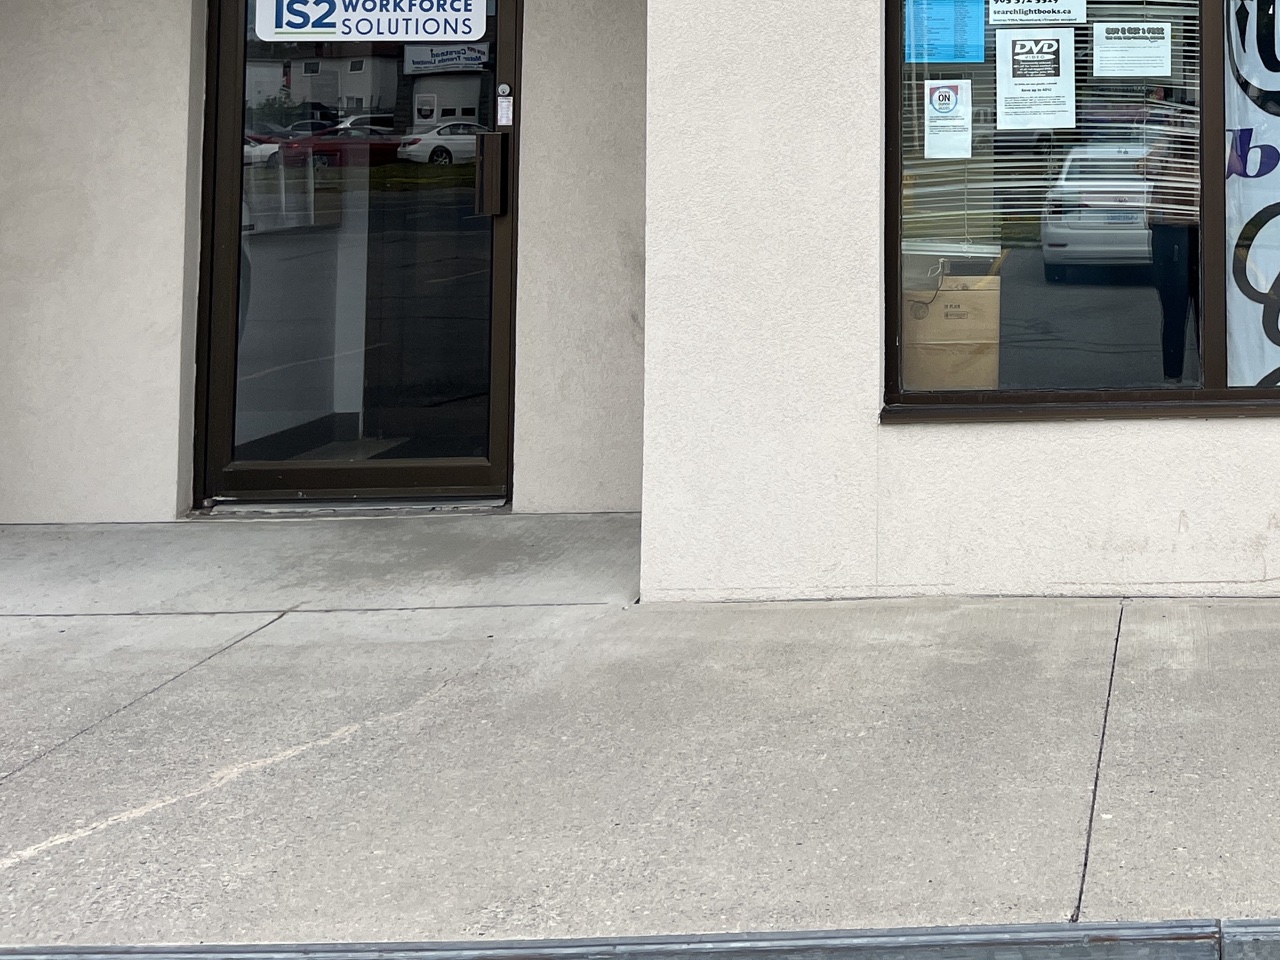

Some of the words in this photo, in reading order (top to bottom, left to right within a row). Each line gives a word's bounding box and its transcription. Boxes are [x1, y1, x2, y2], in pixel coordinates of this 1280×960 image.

[993, 8, 1072, 16] searchlightbooks.ca
[341, 17, 473, 36] SOLUTIONS
[1014, 40, 1059, 54] DVD
[938, 93, 951, 102] ON
